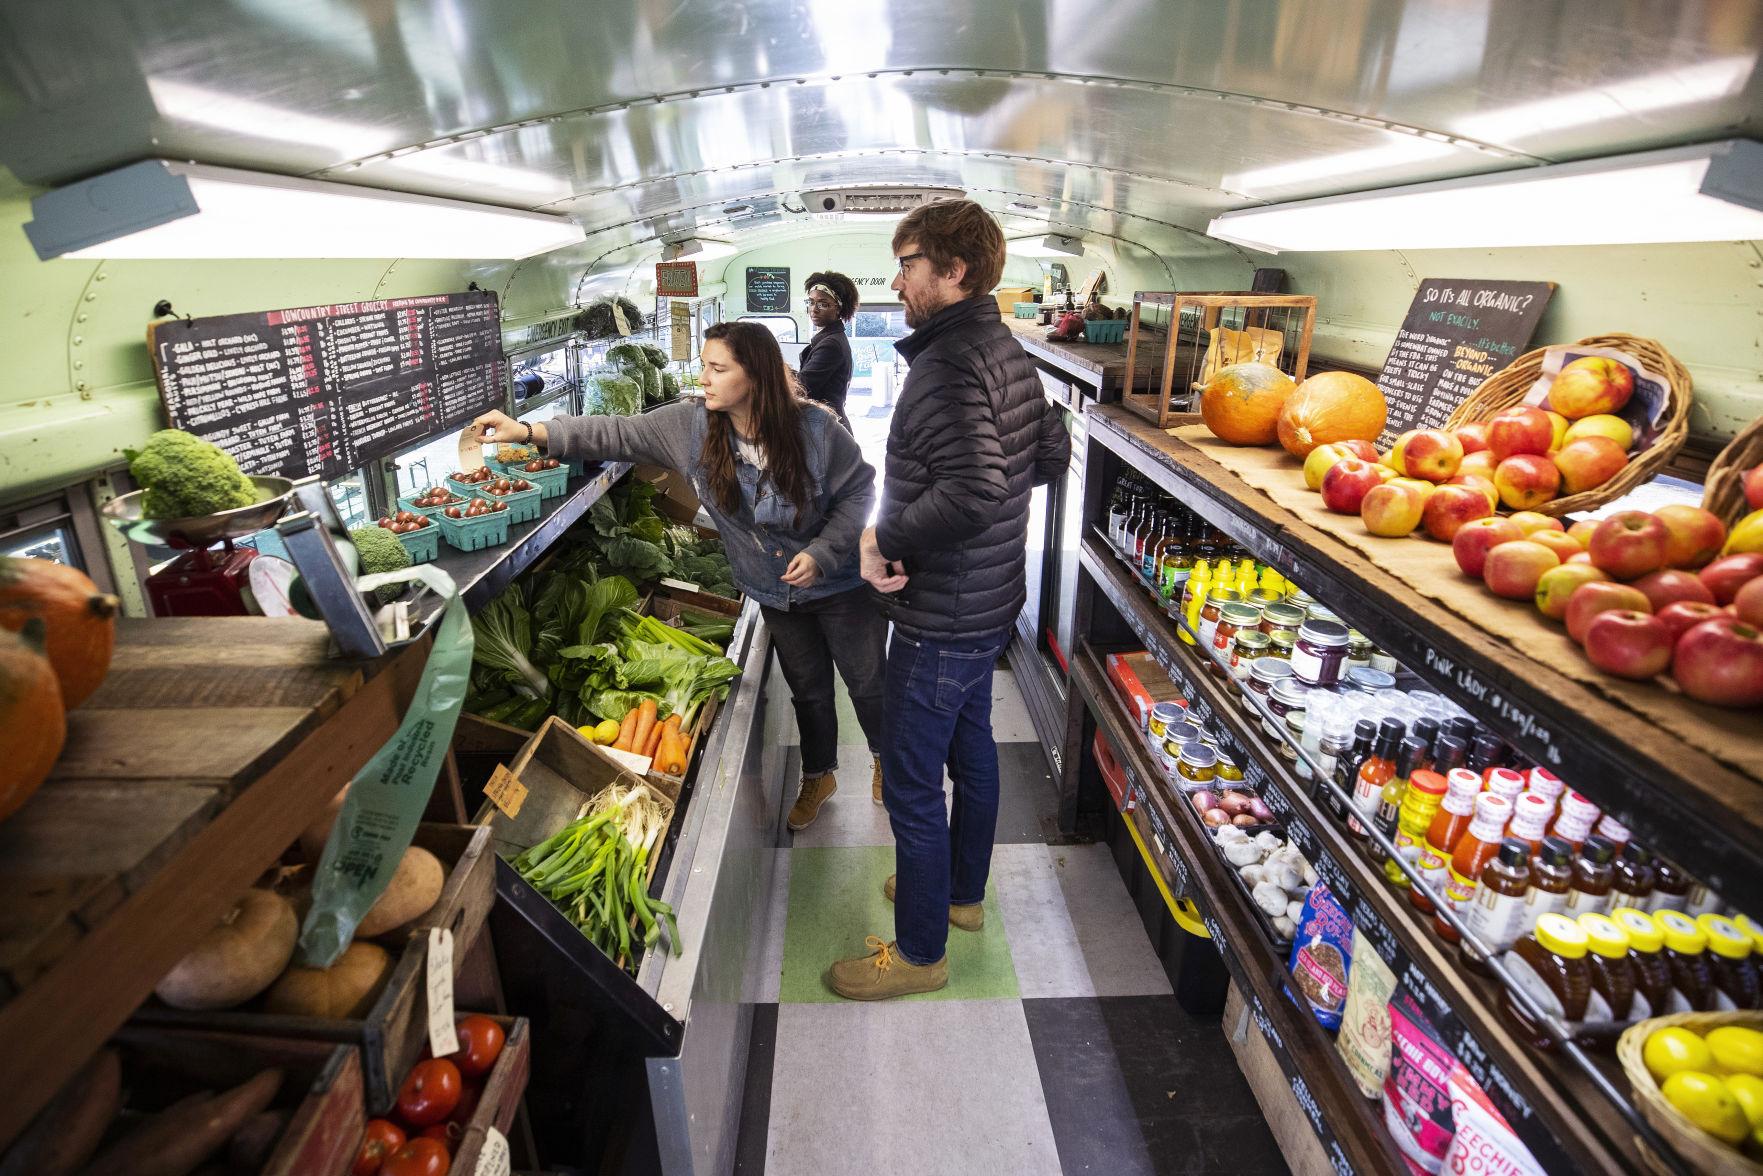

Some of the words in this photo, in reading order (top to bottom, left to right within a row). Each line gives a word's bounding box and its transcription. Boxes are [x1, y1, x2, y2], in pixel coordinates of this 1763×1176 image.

[870, 277, 886, 286] DOOR
[281, 306, 330, 324] LOWCOUNTRY
[336, 302, 359, 315] STREET
[361, 300, 388, 313] GROCERY
[1424, 288, 1438, 303] SO
[1456, 290, 1469, 307] ALL
[1474, 291, 1533, 315] ORGANIC?
[1429, 311, 1443, 322] NOT
[1425, 648, 1454, 677] PINK
[1457, 669, 1488, 701] LADY
[401, 720, 435, 785] Recycled
[380, 753, 400, 785] Made
